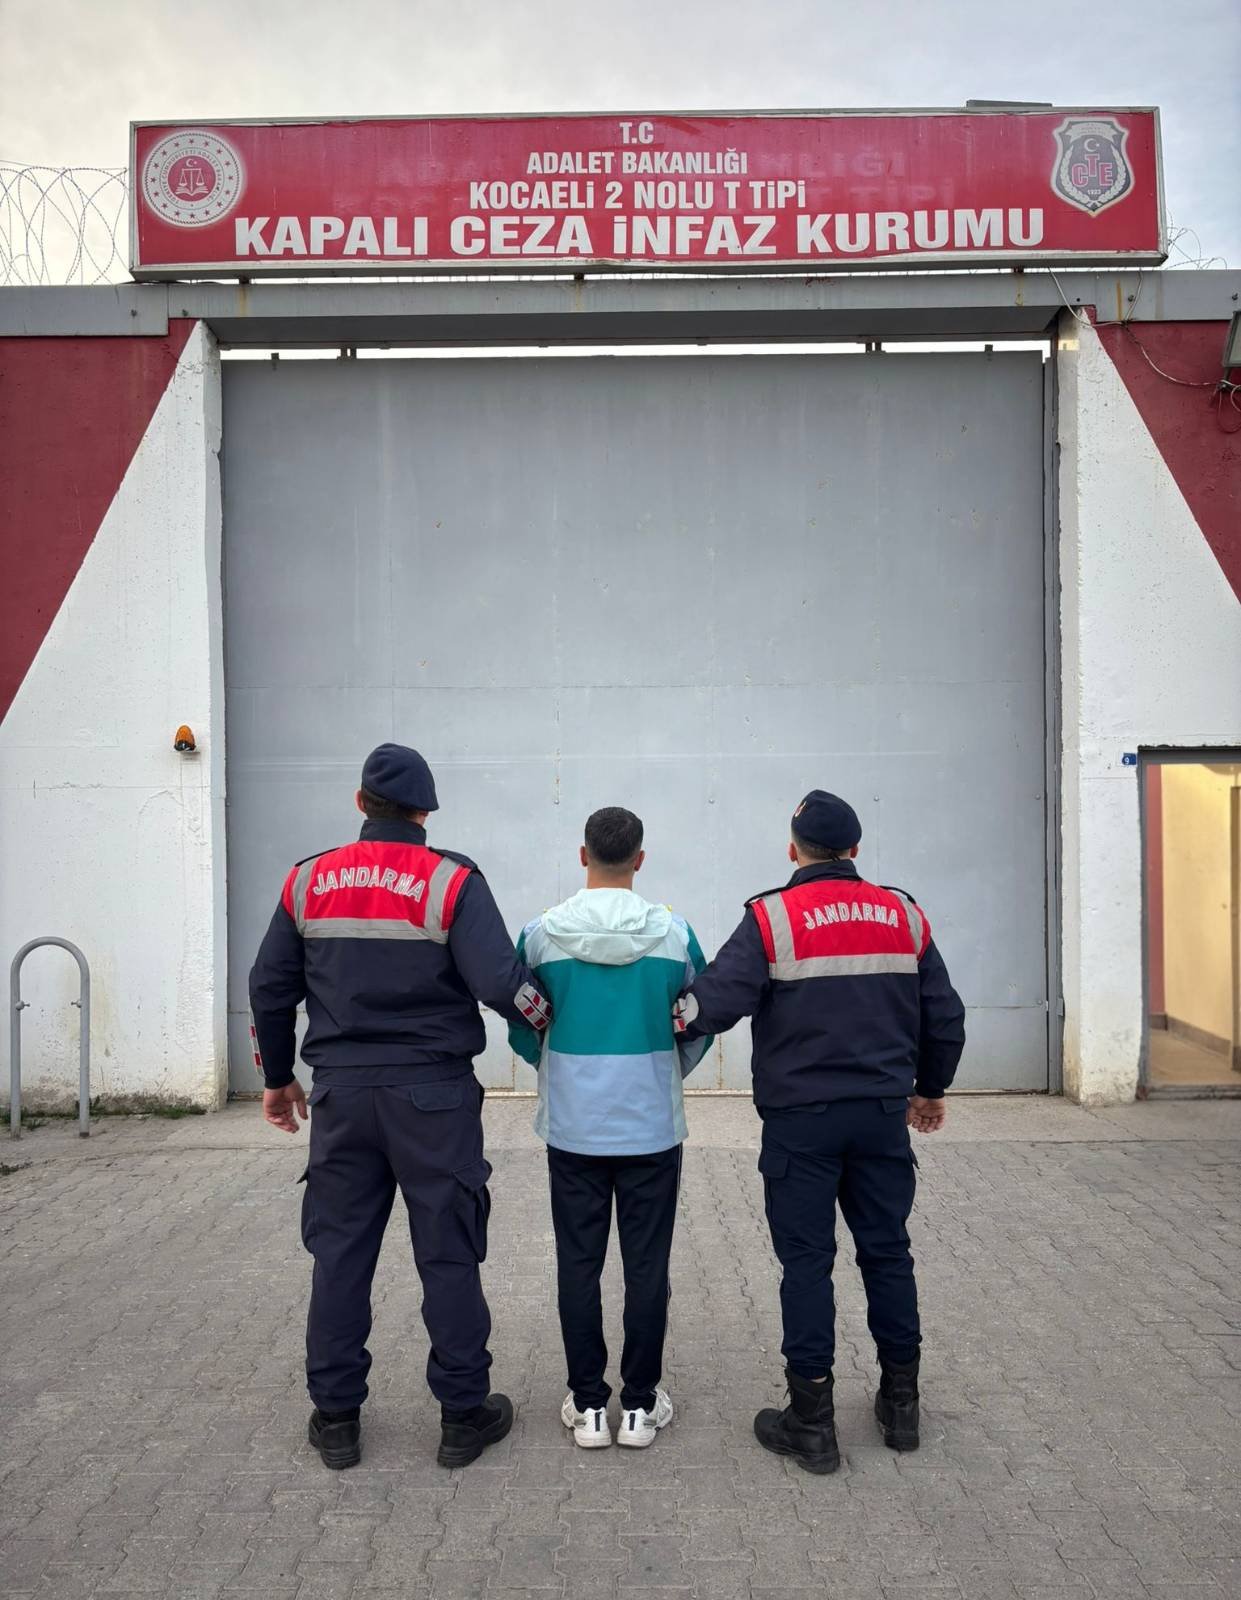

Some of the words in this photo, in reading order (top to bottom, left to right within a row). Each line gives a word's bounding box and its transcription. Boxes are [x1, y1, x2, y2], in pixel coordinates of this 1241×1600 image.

[618, 121, 655, 145] T.C
[526, 151, 615, 175] ADALET
[621, 147, 749, 175] BAKANLIĞI
[604, 180, 623, 209] 2
[633, 180, 715, 210] NOLU
[723, 180, 741, 210] T
[234, 216, 429, 256] KAPALI
[449, 215, 594, 256] CEZA
[796, 207, 1044, 254] KURUMU
[313, 864, 426, 903] JANDARMA
[803, 902, 899, 930] JANDARMA
